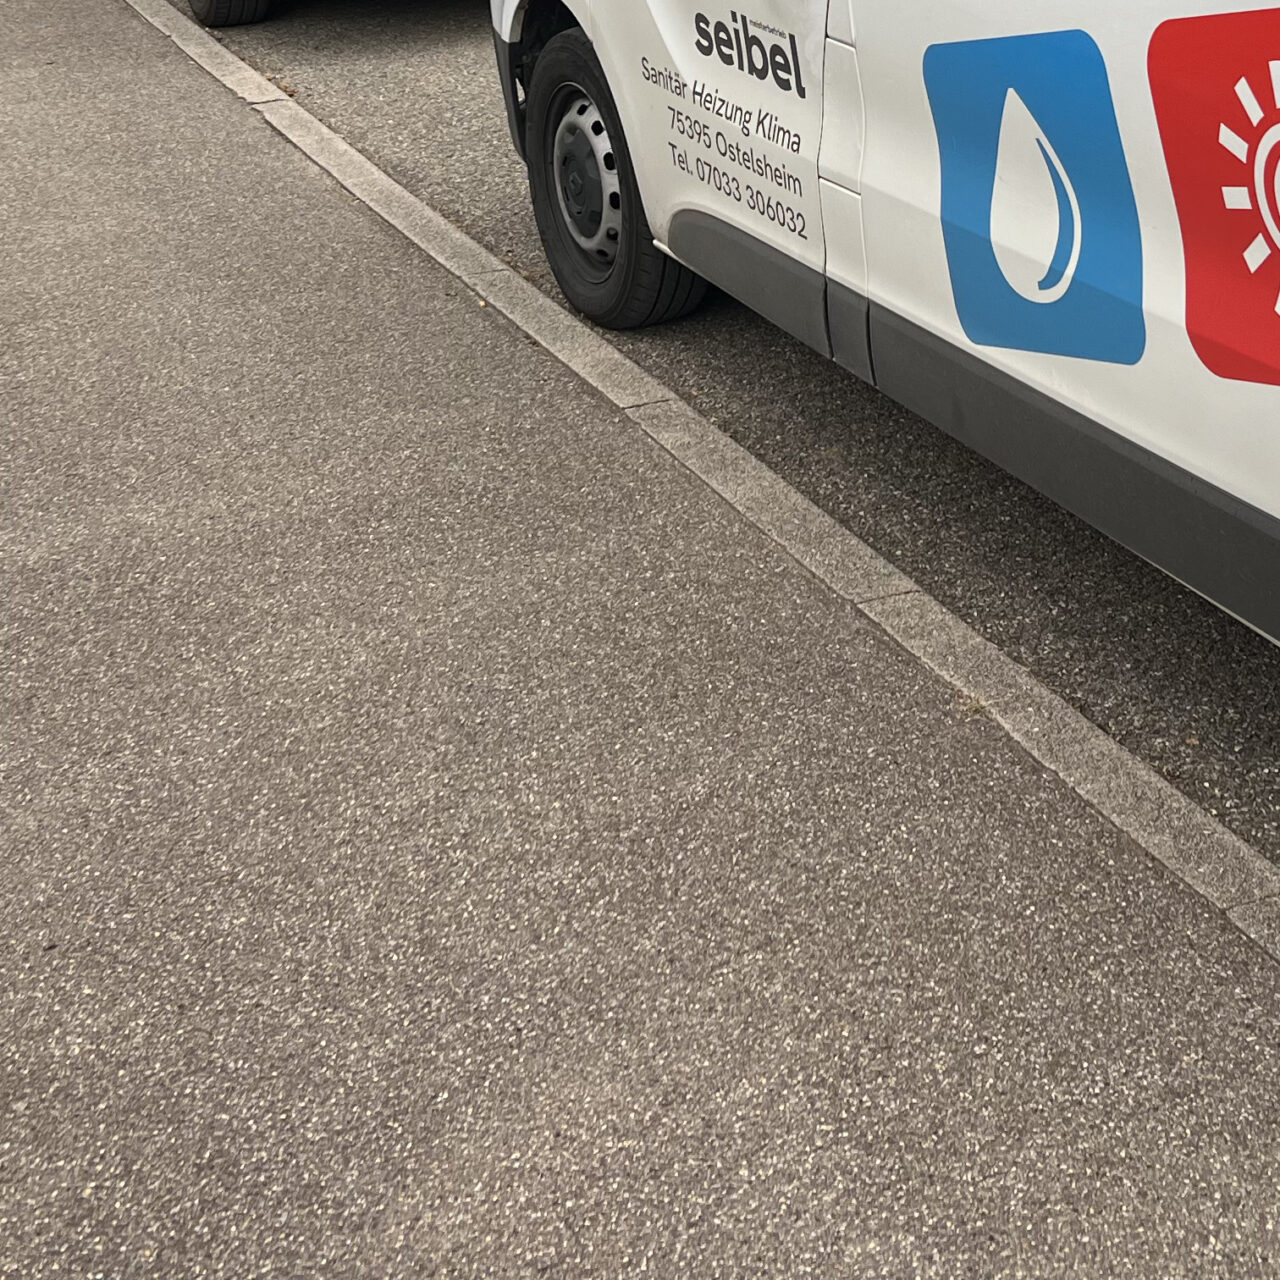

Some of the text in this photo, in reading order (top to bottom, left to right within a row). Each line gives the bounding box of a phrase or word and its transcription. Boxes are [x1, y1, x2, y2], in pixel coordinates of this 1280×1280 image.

[694, 10, 806, 99] seibel
[641, 56, 802, 154] Sanitär Heizung Klima
[667, 106, 803, 198] 75395 Ostelsheim
[668, 142, 808, 240] Tel. 07033 306032
